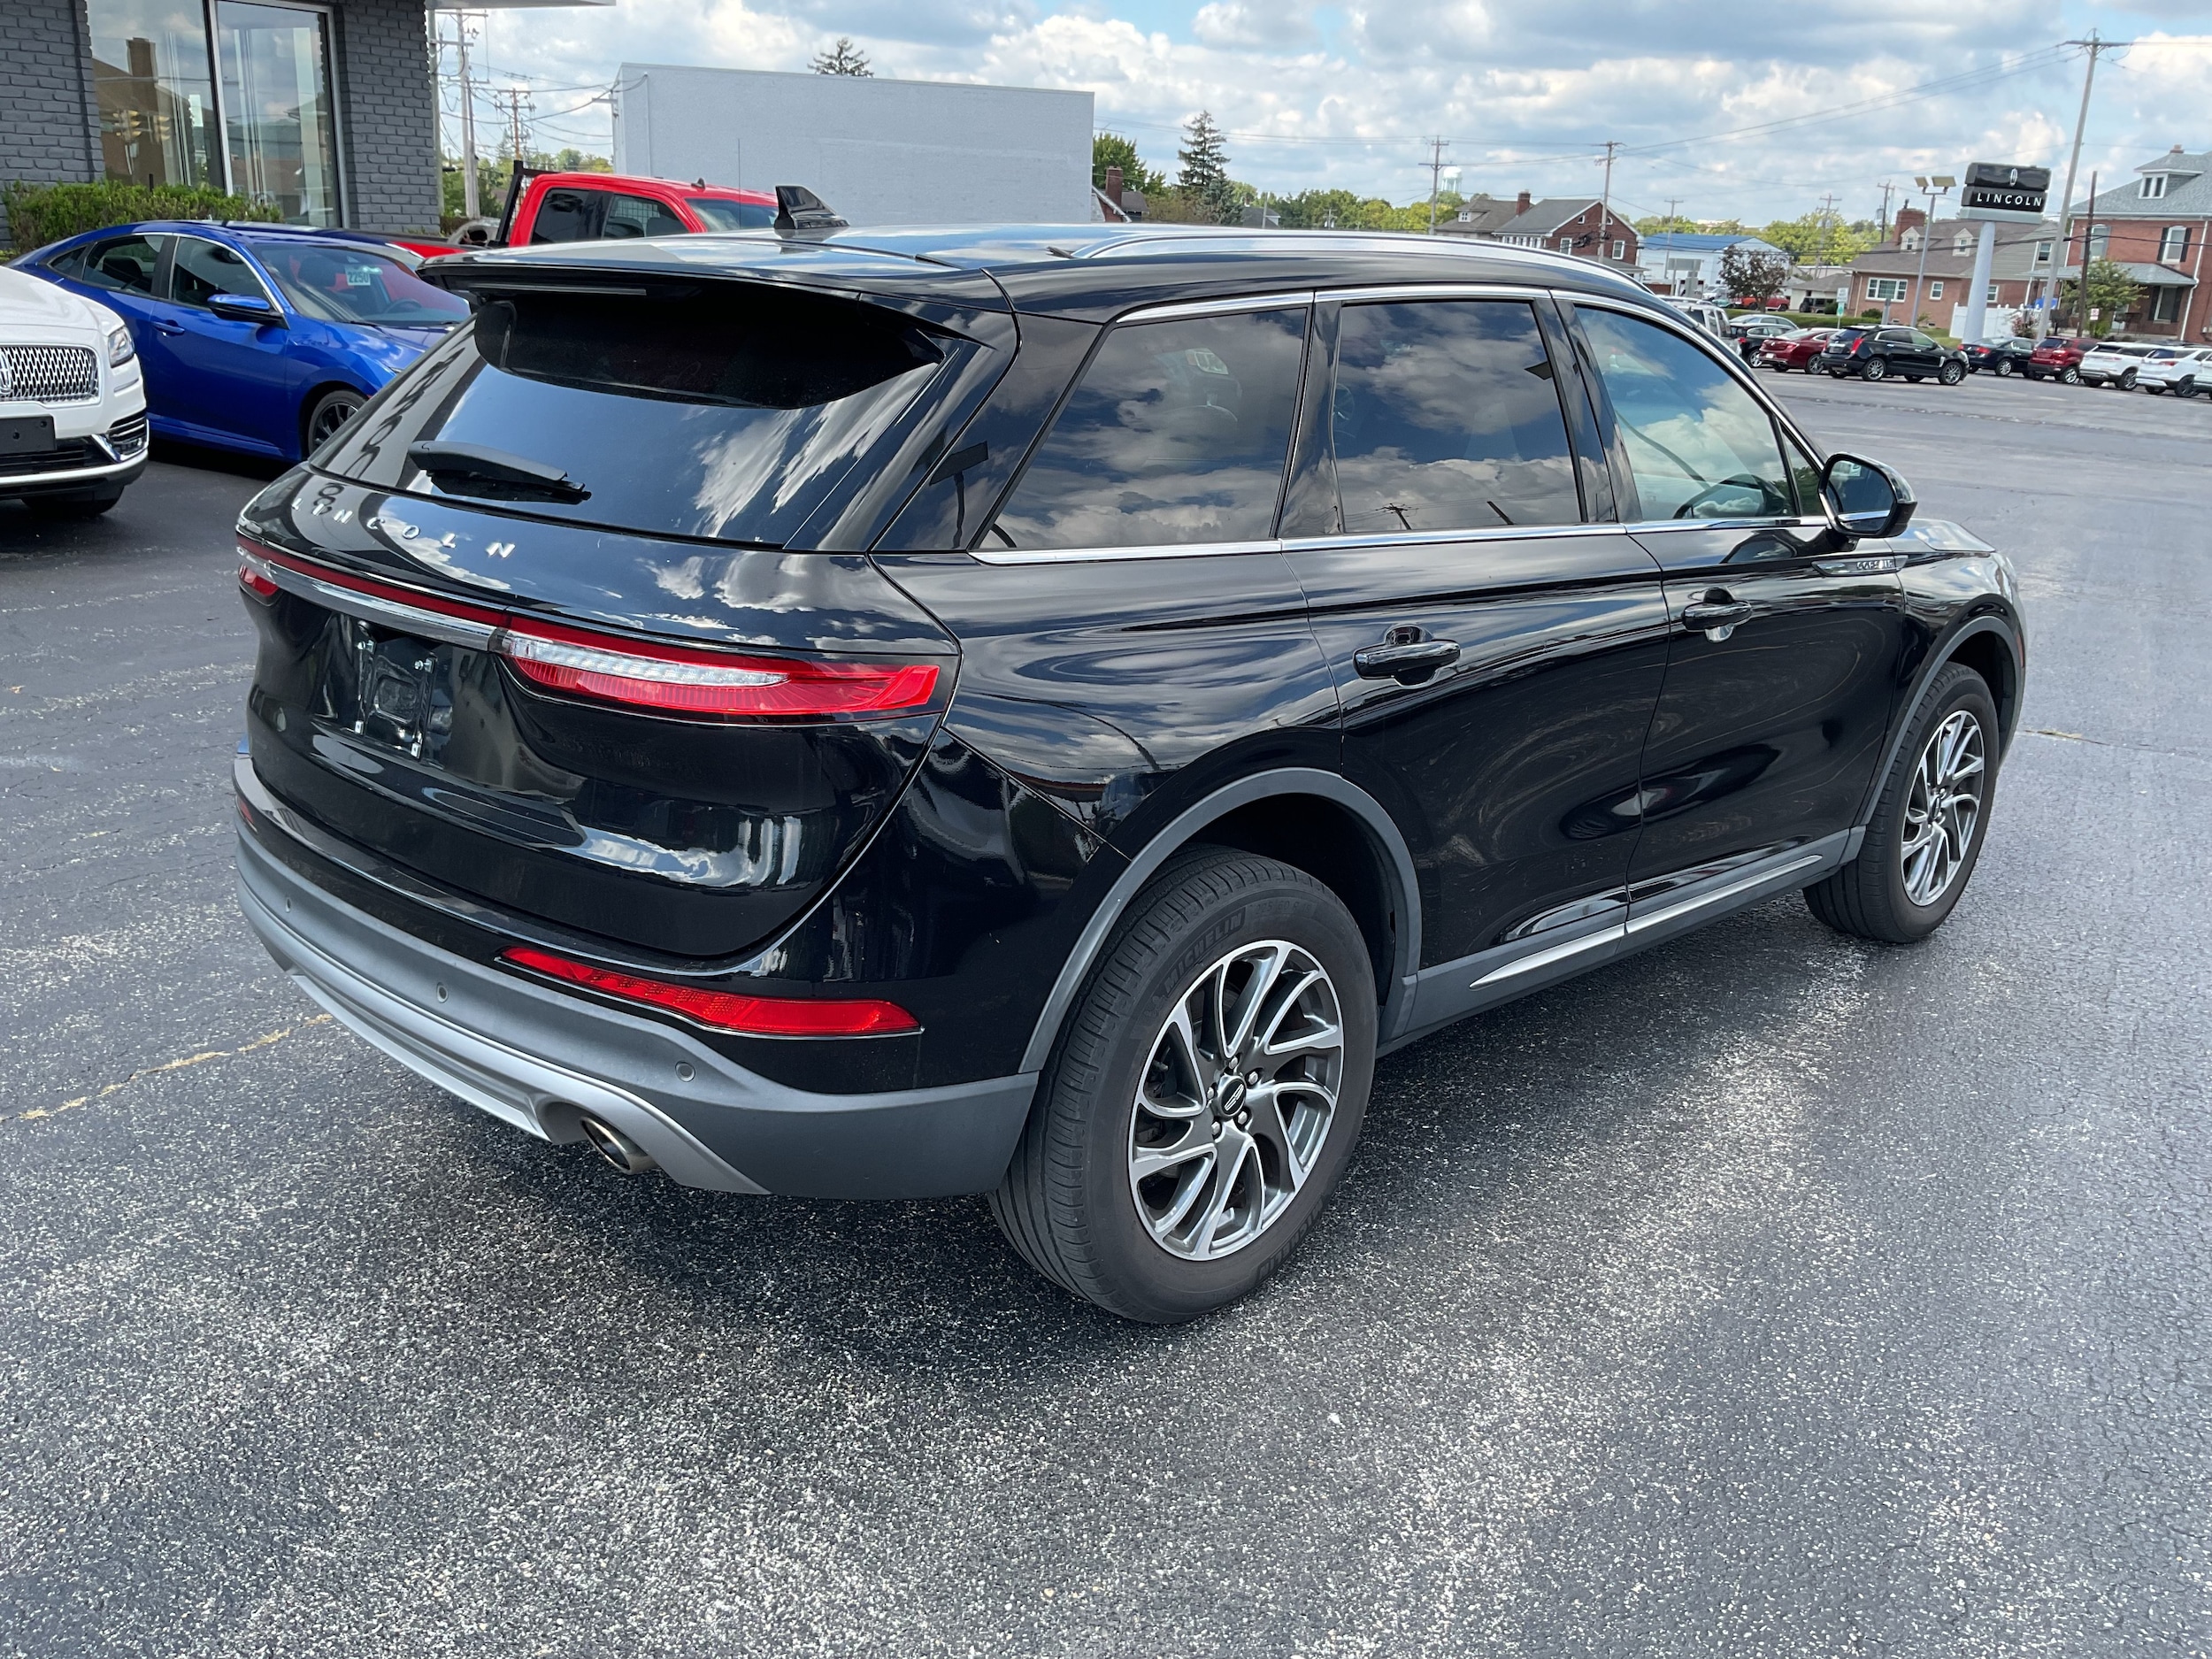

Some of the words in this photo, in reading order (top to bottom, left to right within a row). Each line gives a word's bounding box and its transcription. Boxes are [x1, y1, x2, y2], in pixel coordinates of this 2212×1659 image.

[1977, 192, 2042, 207] LINCOLN
[291, 497, 516, 558] LINCOLN
[1164, 912, 1242, 994] MICHELIN
